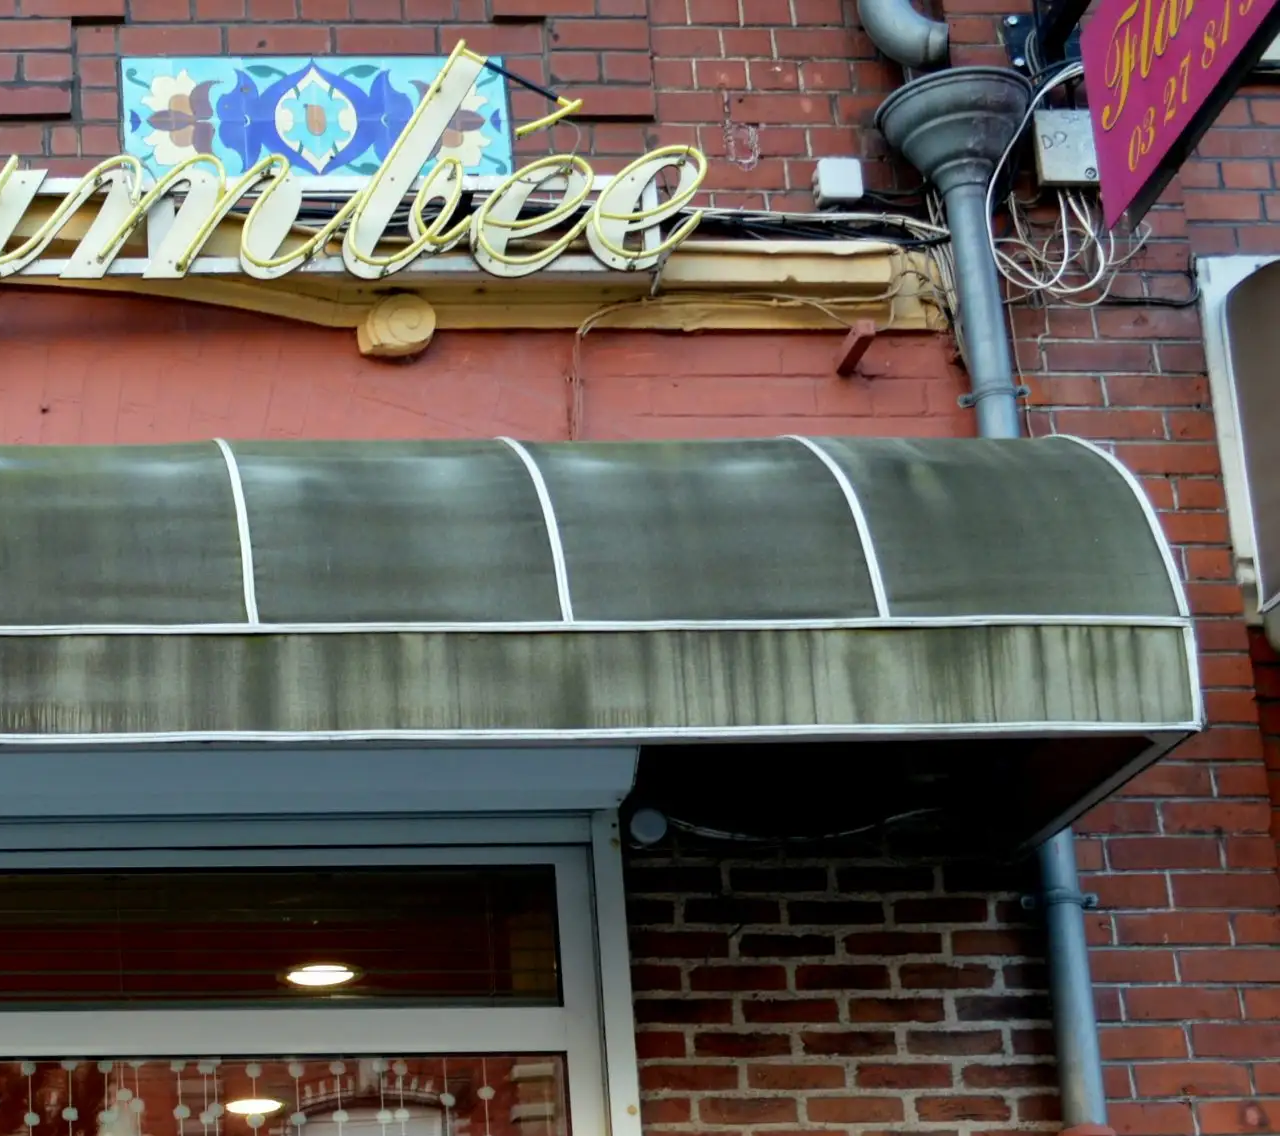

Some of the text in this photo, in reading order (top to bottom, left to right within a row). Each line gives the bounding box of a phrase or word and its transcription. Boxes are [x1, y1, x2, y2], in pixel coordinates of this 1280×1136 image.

[1101, 0, 1196, 131] Fla
[1127, 106, 1157, 172] 03
[1163, 50, 1192, 127] 27
